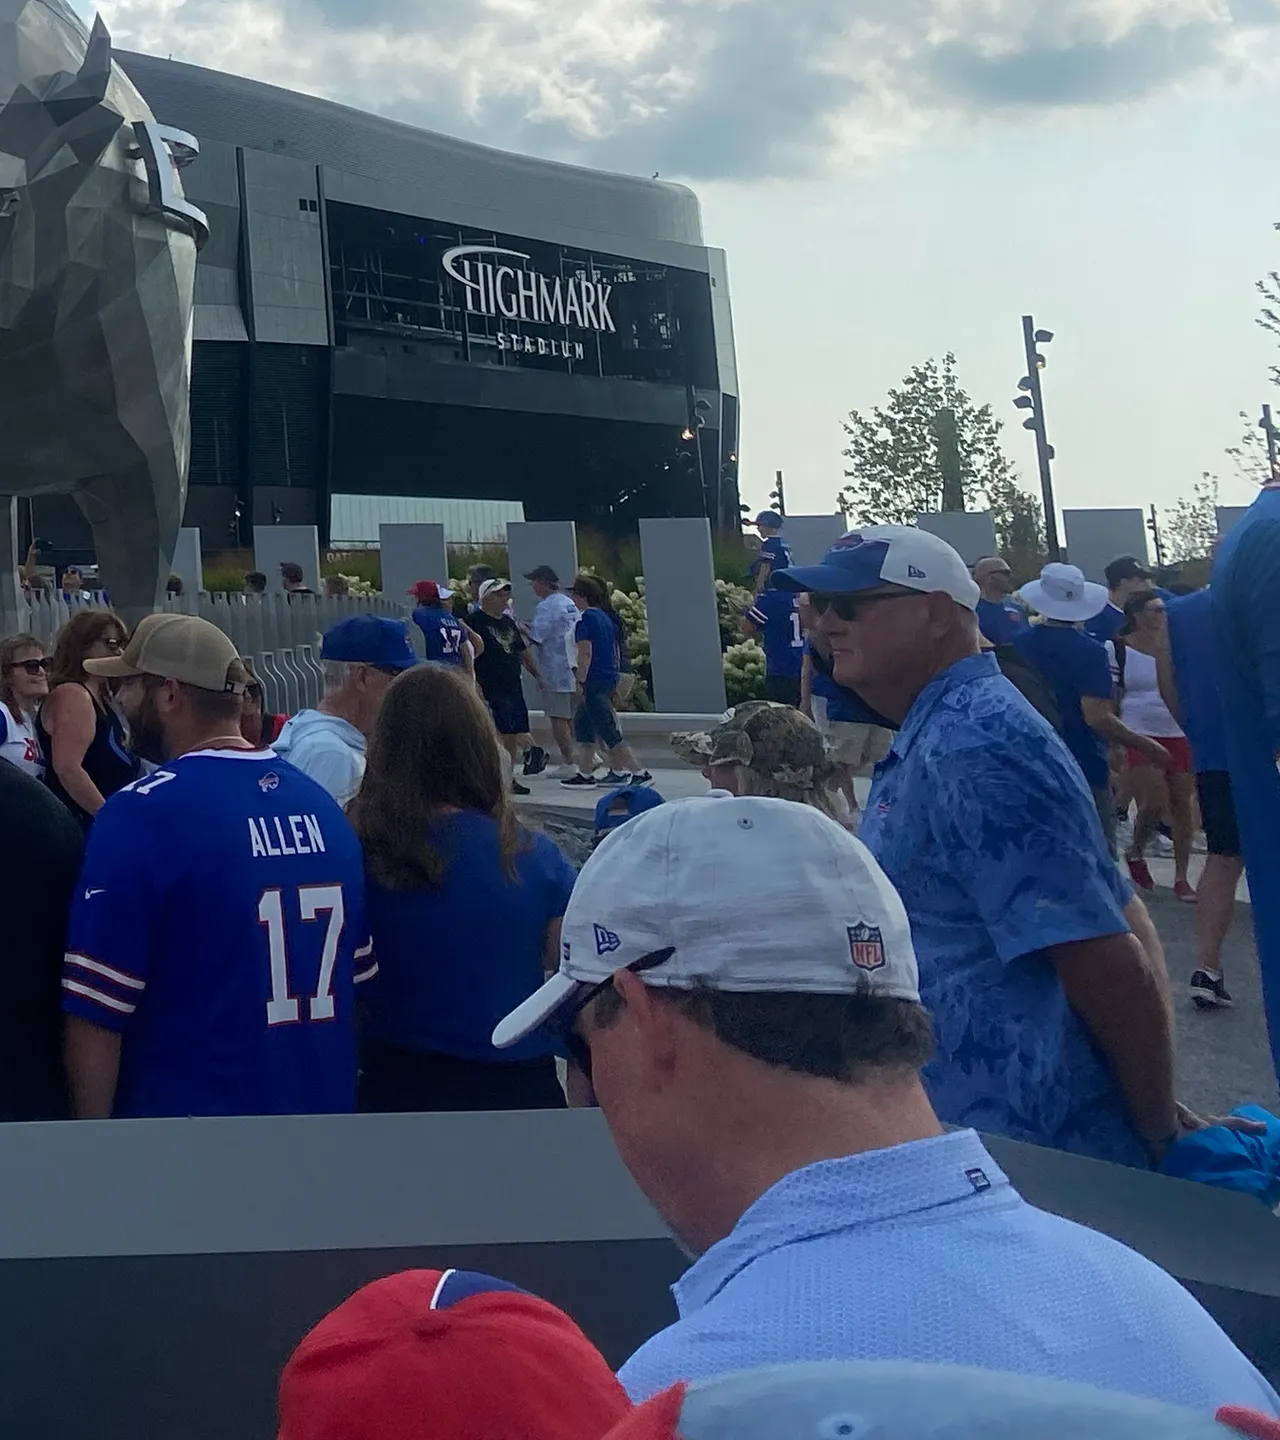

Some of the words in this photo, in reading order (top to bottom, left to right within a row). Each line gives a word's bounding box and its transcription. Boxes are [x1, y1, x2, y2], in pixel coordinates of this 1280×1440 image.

[442, 245, 616, 333] HIGHMARK
[496, 332, 584, 360] STADIUM
[440, 627, 461, 653] 17
[248, 814, 326, 858] ALLEN
[257, 883, 345, 1027] 17
[853, 943, 882, 965] NFL
